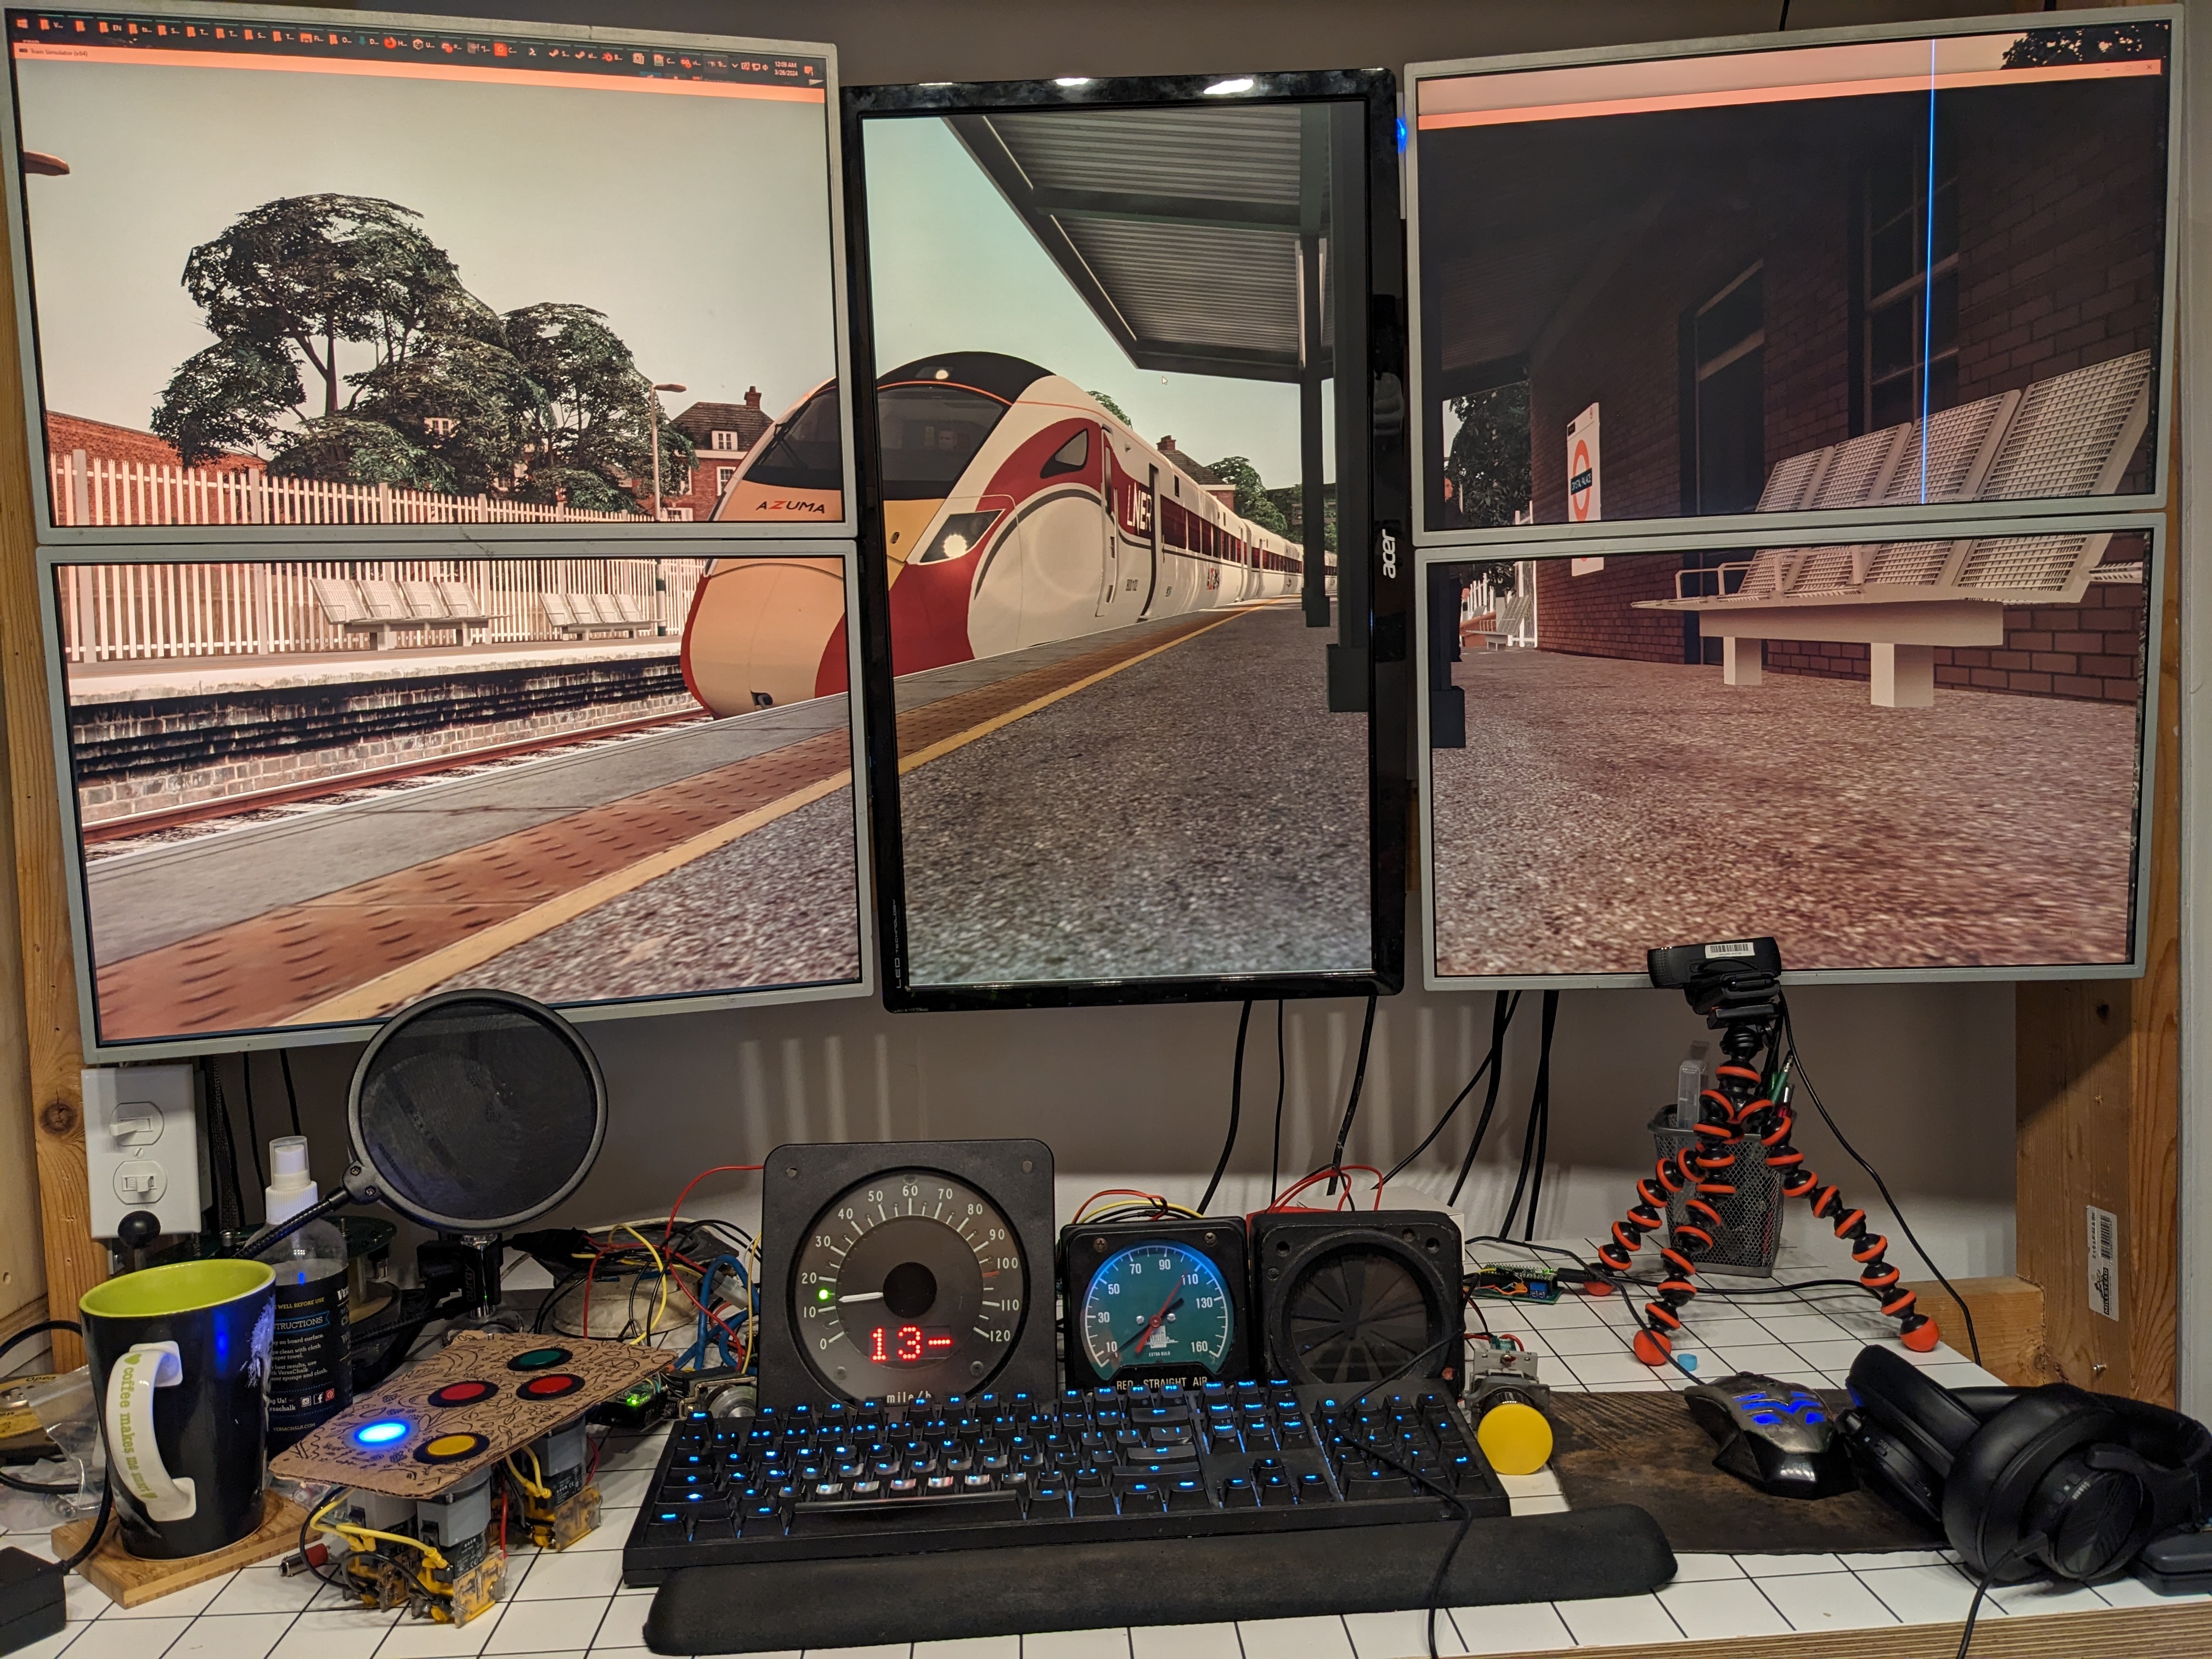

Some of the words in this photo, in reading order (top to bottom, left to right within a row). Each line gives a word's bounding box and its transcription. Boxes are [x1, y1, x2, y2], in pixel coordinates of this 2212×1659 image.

[755, 500, 825, 514] AZUMA
[1126, 481, 1152, 536] LNER
[1382, 528, 1396, 579] acer
[868, 1190, 883, 1201] 50
[902, 1185, 918, 1197] 60
[938, 1188, 953, 1200] 70
[838, 1208, 853, 1220] 40
[967, 1204, 983, 1215] 80
[989, 1229, 1005, 1240] 90
[815, 1235, 831, 1248] 30
[997, 1257, 1018, 1269] 100
[1130, 1263, 1142, 1274] 70
[1159, 1259, 1171, 1271] 90
[802, 1272, 817, 1284] 20
[1181, 1273, 1198, 1285] 110
[1108, 1283, 1120, 1295] 50
[294, 1300, 314, 1308] BEFORE
[1002, 1299, 1019, 1311] 110
[1196, 1297, 1213, 1308] 130
[804, 1306, 816, 1318] 10
[1098, 1311, 1110, 1323] 30
[990, 1329, 1011, 1342] 120
[820, 1338, 827, 1350] 0
[1106, 1341, 1118, 1352] 10
[1190, 1341, 1208, 1353] 160
[278, 1367, 309, 1375] VersaChalk
[120, 1367, 134, 1408] coffee
[1116, 1380, 1134, 1390] RED
[1143, 1377, 1187, 1389] STRAIGHT
[1192, 1376, 1208, 1387] AIR
[120, 1413, 135, 1453] makes
[126, 1457, 139, 1470] me
[131, 1472, 151, 1492] smart
